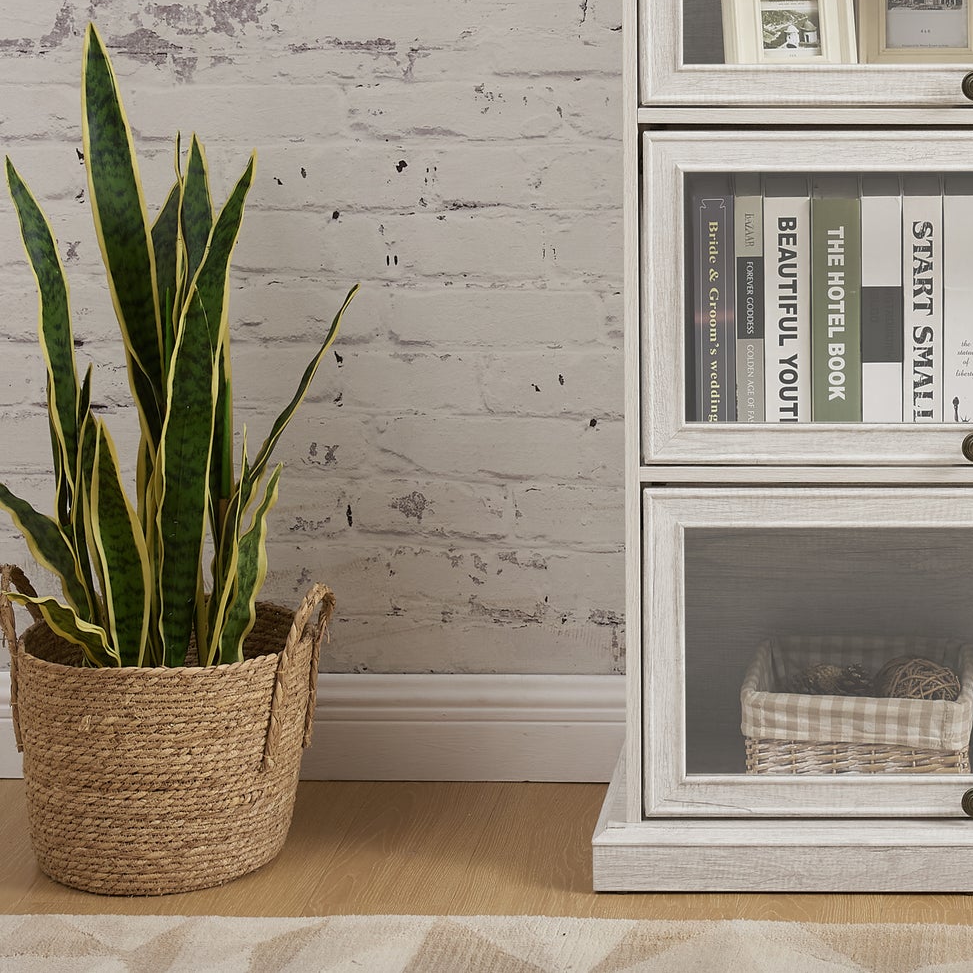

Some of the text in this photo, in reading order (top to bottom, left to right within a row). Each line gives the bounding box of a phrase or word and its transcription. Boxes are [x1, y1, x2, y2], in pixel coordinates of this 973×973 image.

[745, 213, 754, 247] BAZAAR
[913, 221, 933, 316] START
[708, 221, 720, 422] Bride & Groom's wedding
[746, 261, 754, 334] FOREVER GODDESS
[778, 217, 798, 346] BEAUTIFUL
[828, 226, 846, 401] THE HOTEL BOOK
[747, 397, 754, 408] OF
[963, 358, 970, 366] of
